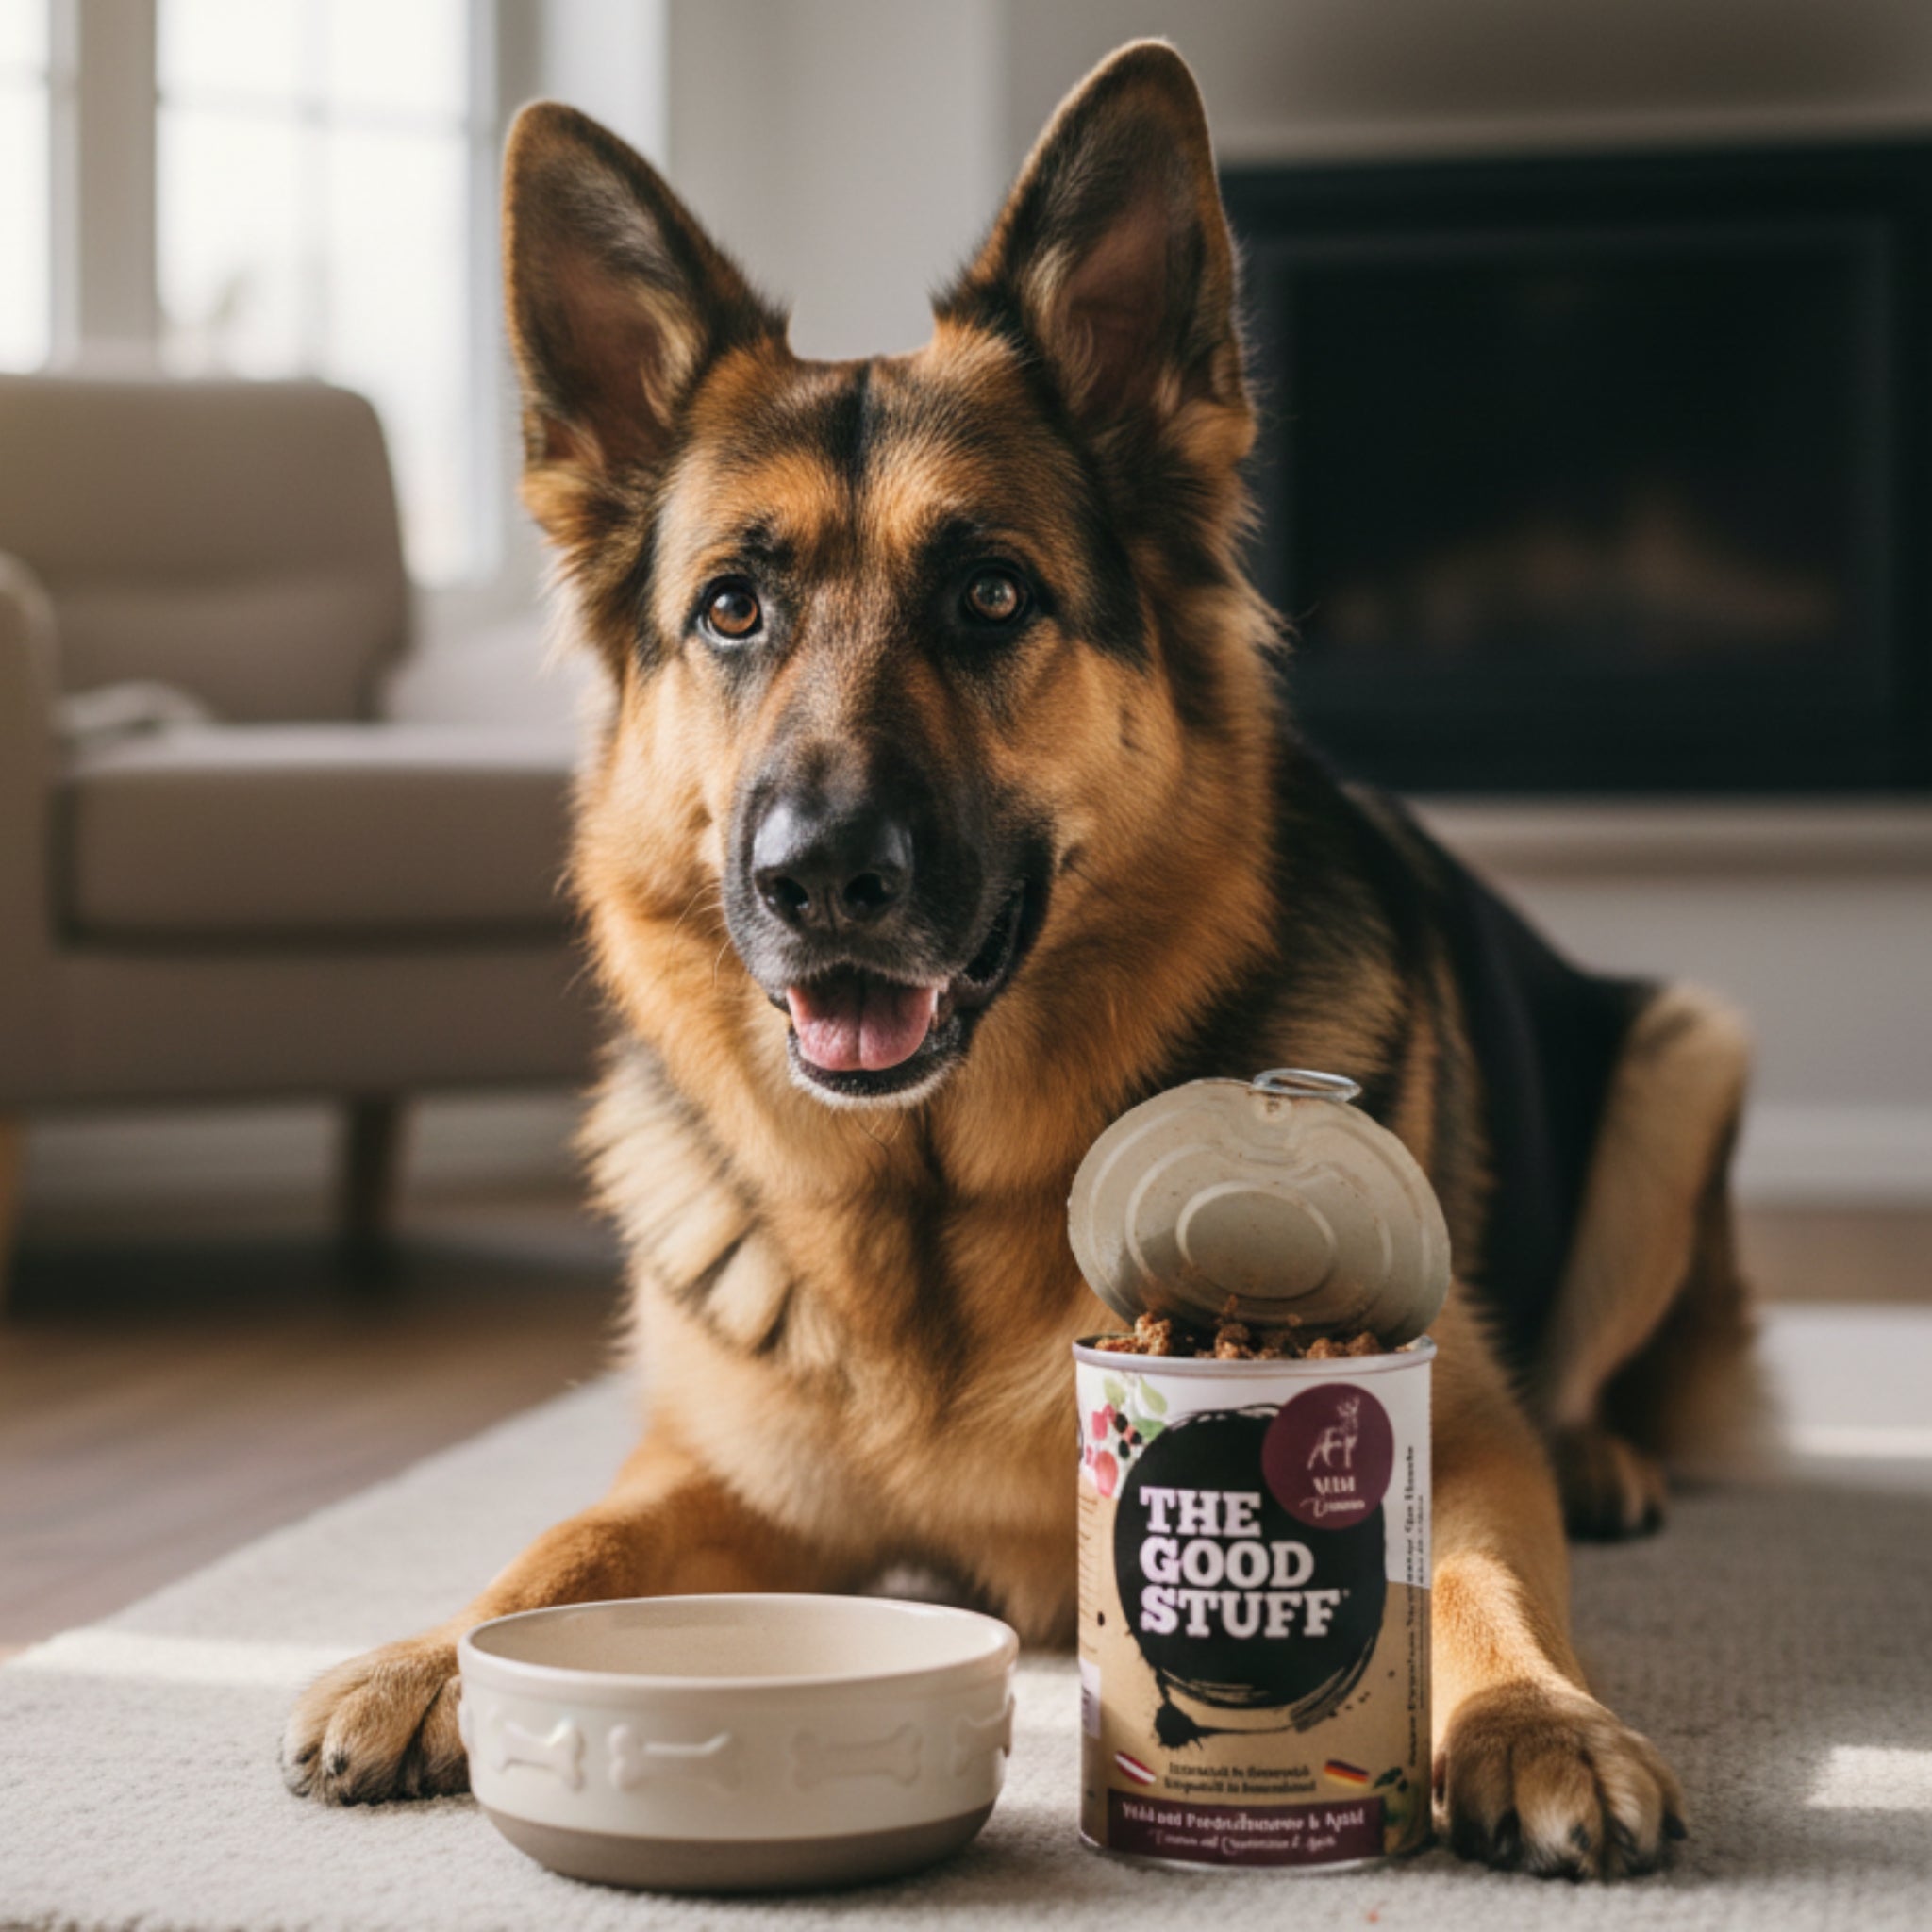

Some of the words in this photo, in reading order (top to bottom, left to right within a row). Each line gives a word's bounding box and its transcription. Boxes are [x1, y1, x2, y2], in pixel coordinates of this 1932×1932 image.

[1139, 1485, 1261, 1538] THE
[1139, 1535, 1315, 1590] GOOD
[1140, 1584, 1341, 1640] STUFF
